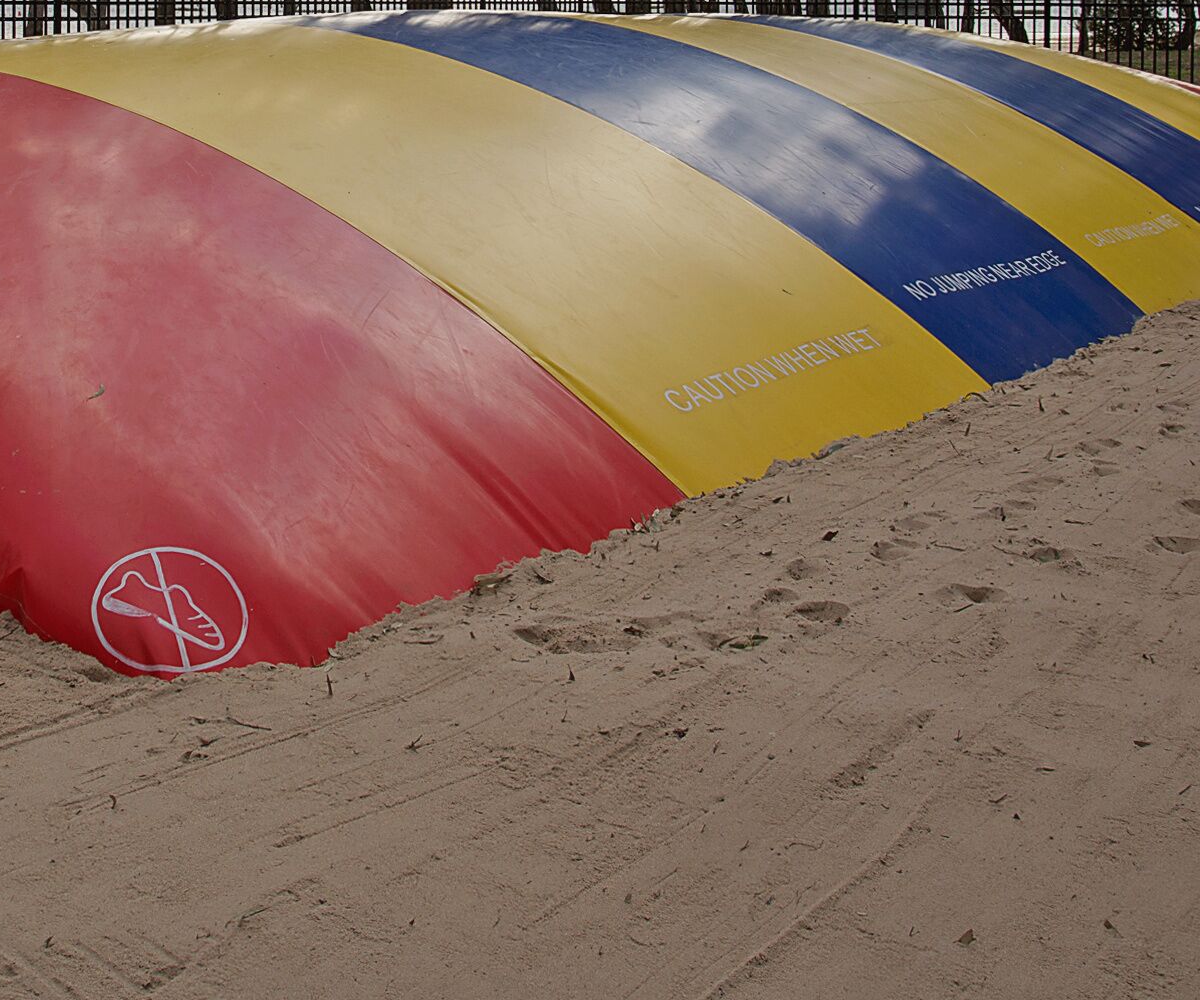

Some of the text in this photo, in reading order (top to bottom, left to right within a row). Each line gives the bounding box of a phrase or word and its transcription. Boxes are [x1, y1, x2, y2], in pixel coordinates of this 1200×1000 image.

[1084, 224, 1138, 247] CAUTION
[903, 250, 1066, 301] NO JUMPING NEAR EDGE
[664, 328, 881, 412] CAUTION WHEN WET
